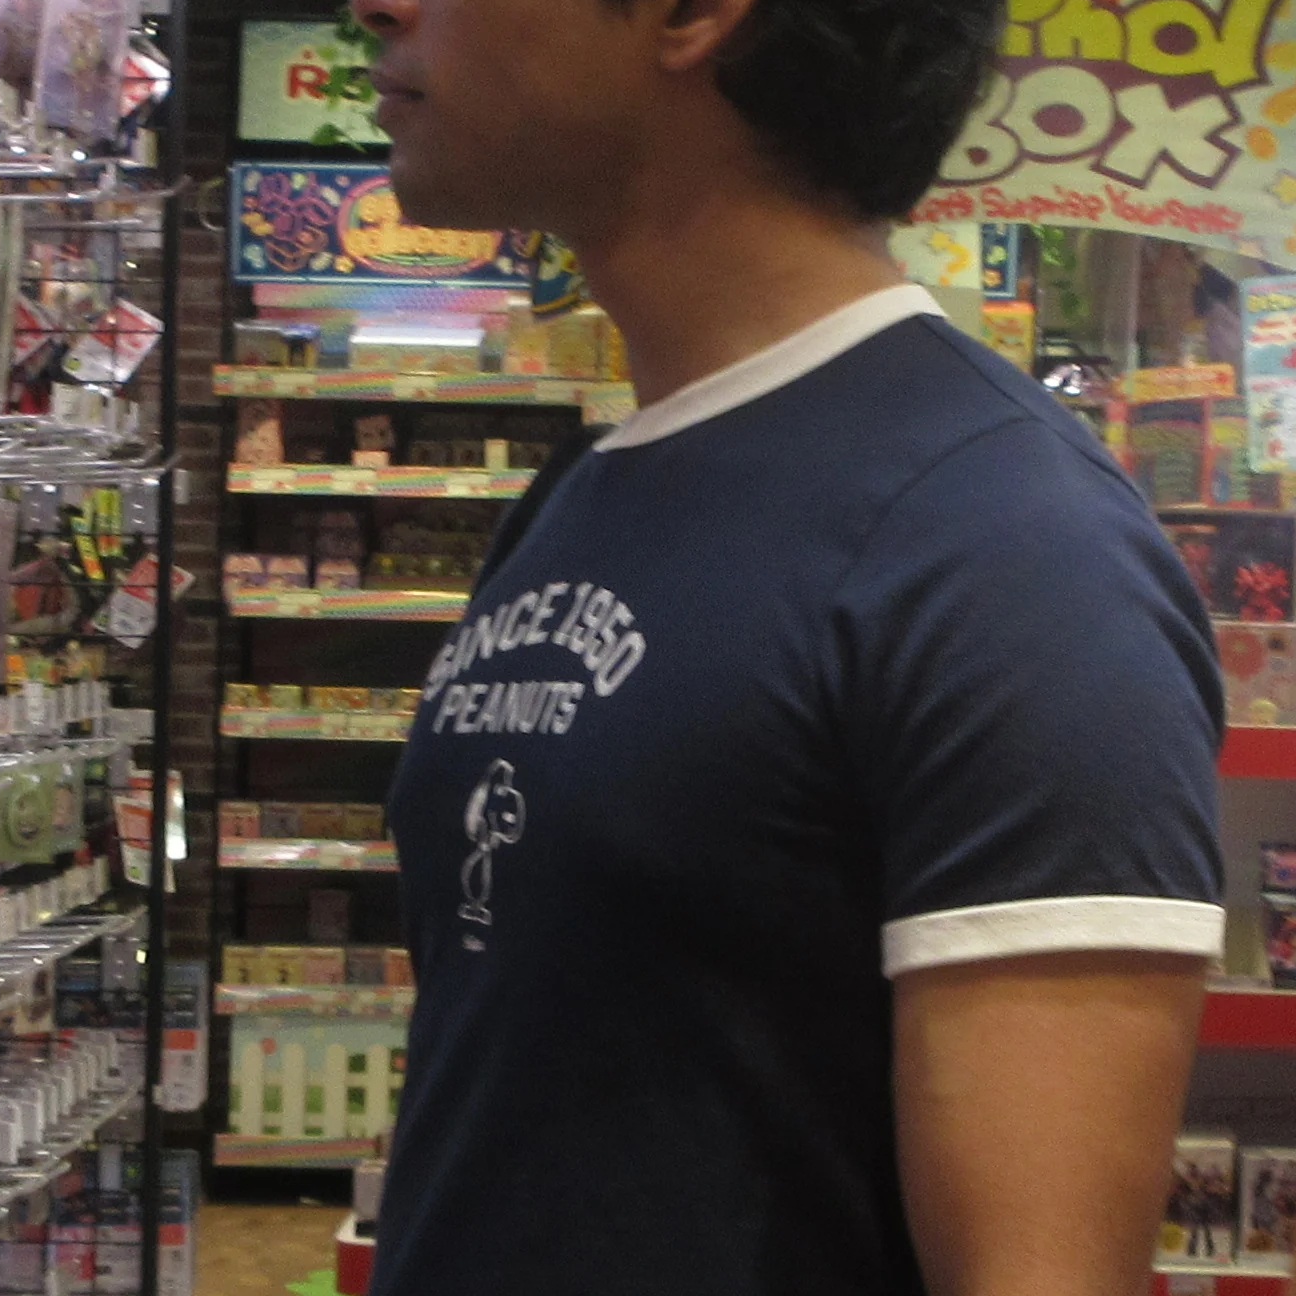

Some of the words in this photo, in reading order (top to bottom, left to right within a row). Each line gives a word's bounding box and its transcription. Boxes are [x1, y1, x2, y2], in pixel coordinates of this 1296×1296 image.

[422, 581, 570, 702] SINCE
[551, 581, 647, 698] 1950
[431, 680, 586, 735] PEANUTS
